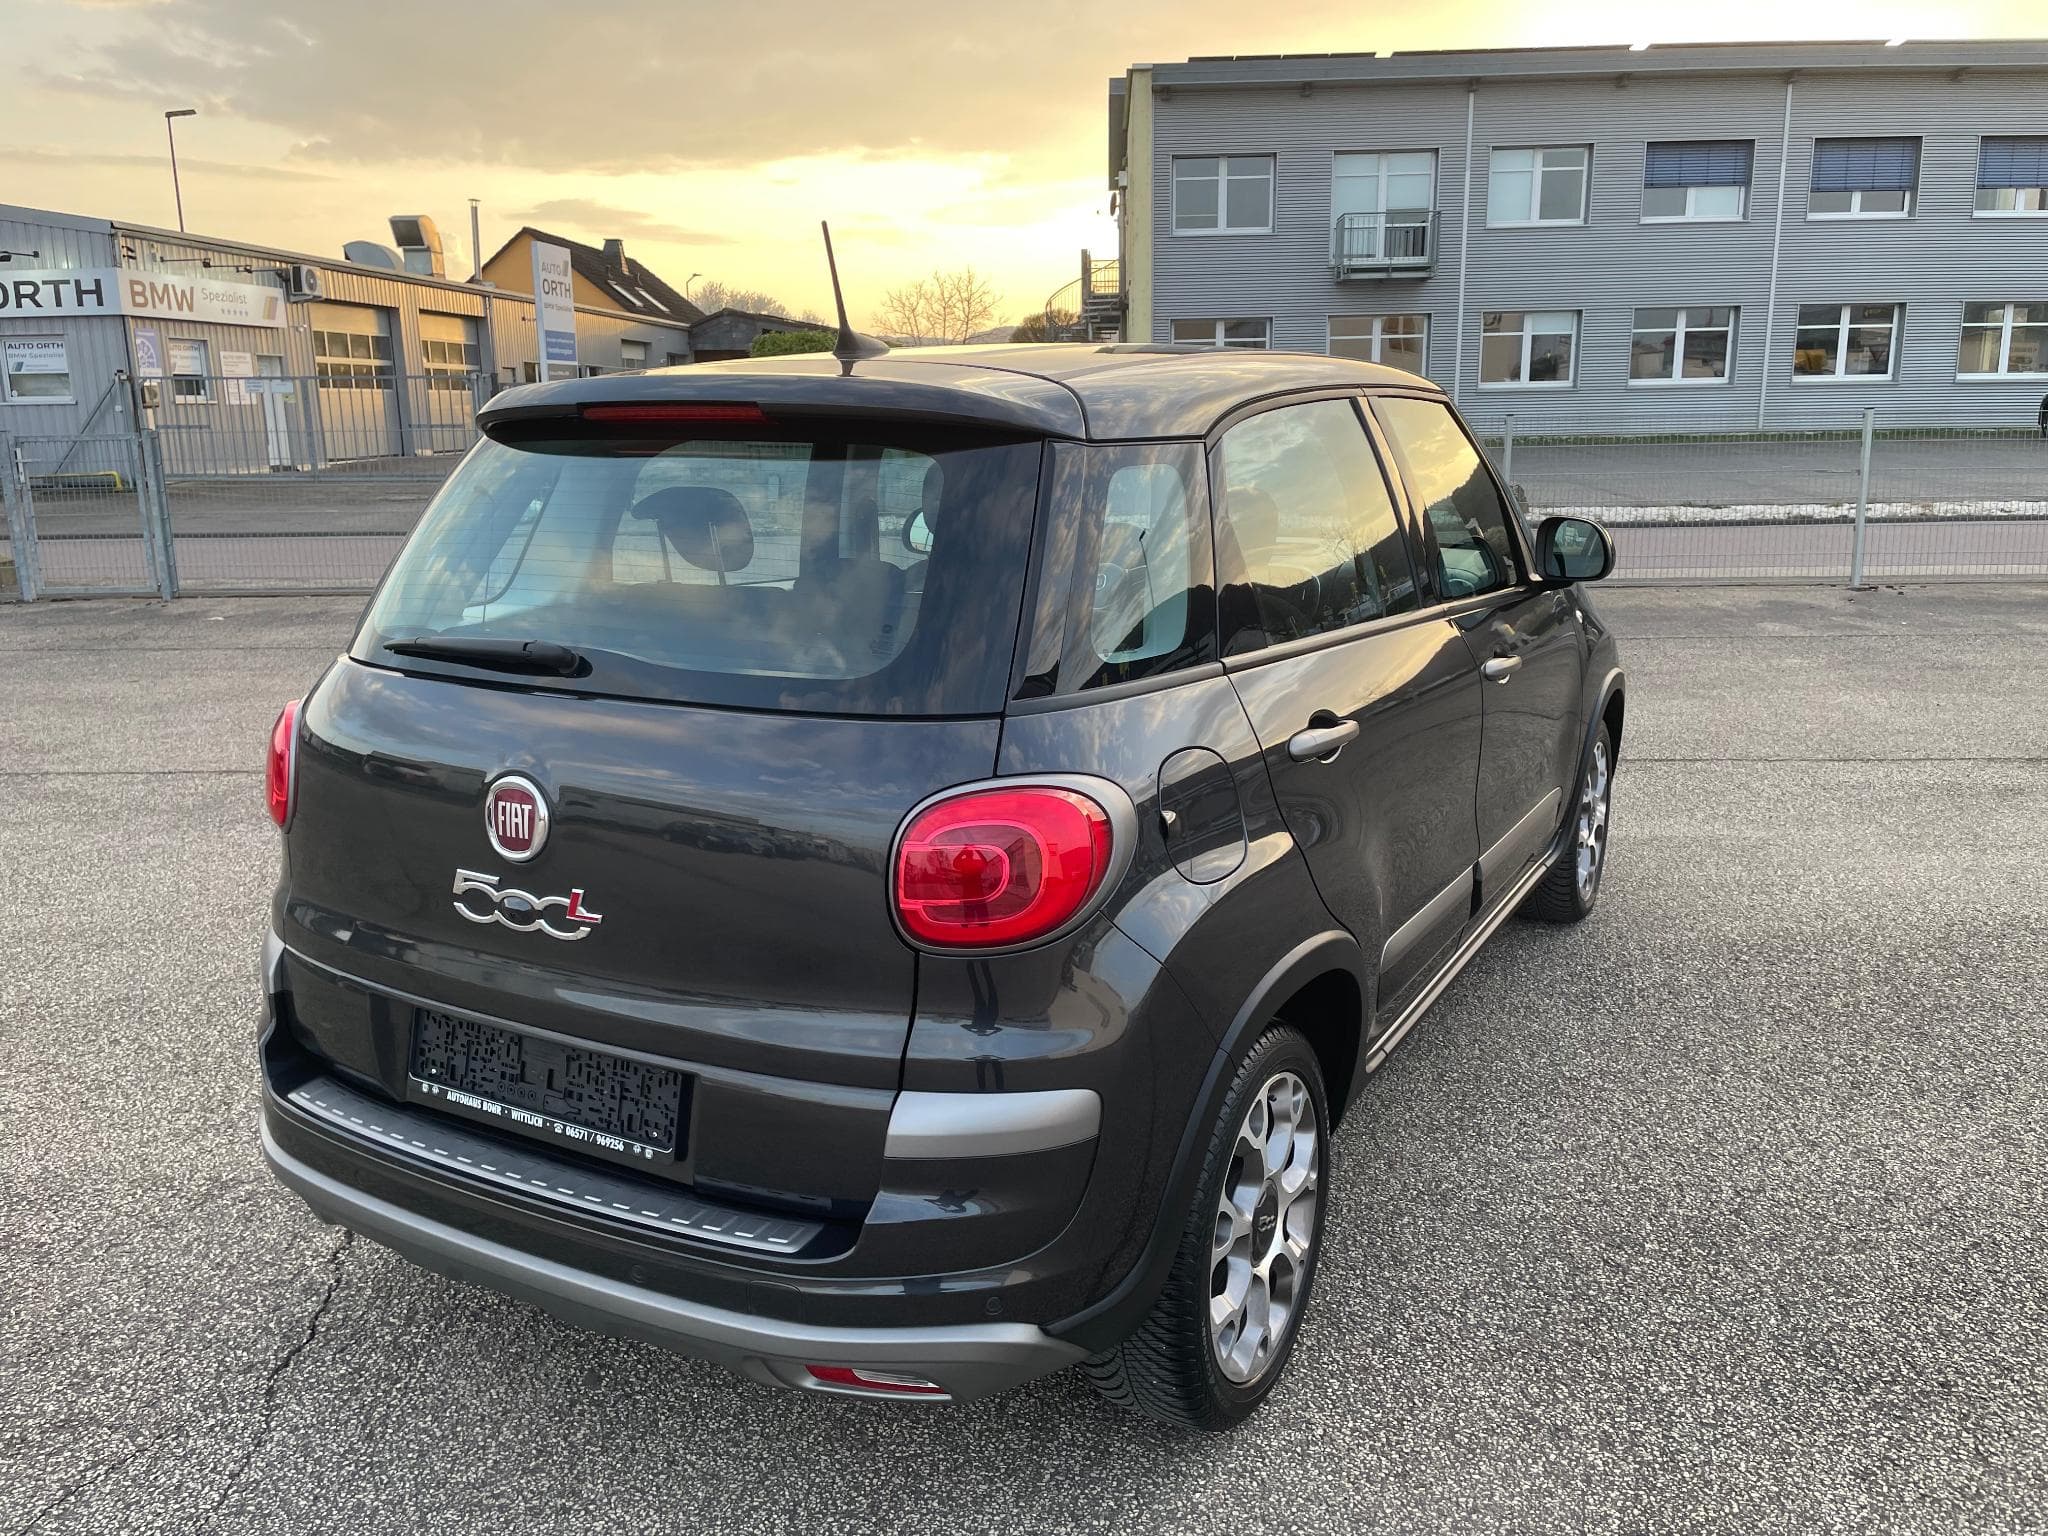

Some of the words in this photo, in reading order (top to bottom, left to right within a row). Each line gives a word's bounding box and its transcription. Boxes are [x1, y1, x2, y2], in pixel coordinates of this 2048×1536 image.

[542, 262, 561, 276] AUTO
[129, 279, 194, 312] BMW
[201, 287, 248, 305] Spezialist
[543, 278, 571, 299] ORTH
[7, 342, 34, 350] AUTO
[36, 342, 64, 350] ORTH
[498, 801, 533, 840] FIAT
[446, 1090, 481, 1109] AUTOHAUS
[482, 1101, 502, 1116] BOHR
[511, 1108, 543, 1128] WITTLICH
[565, 1125, 588, 1141] 06571
[596, 1134, 624, 1152] 969256
